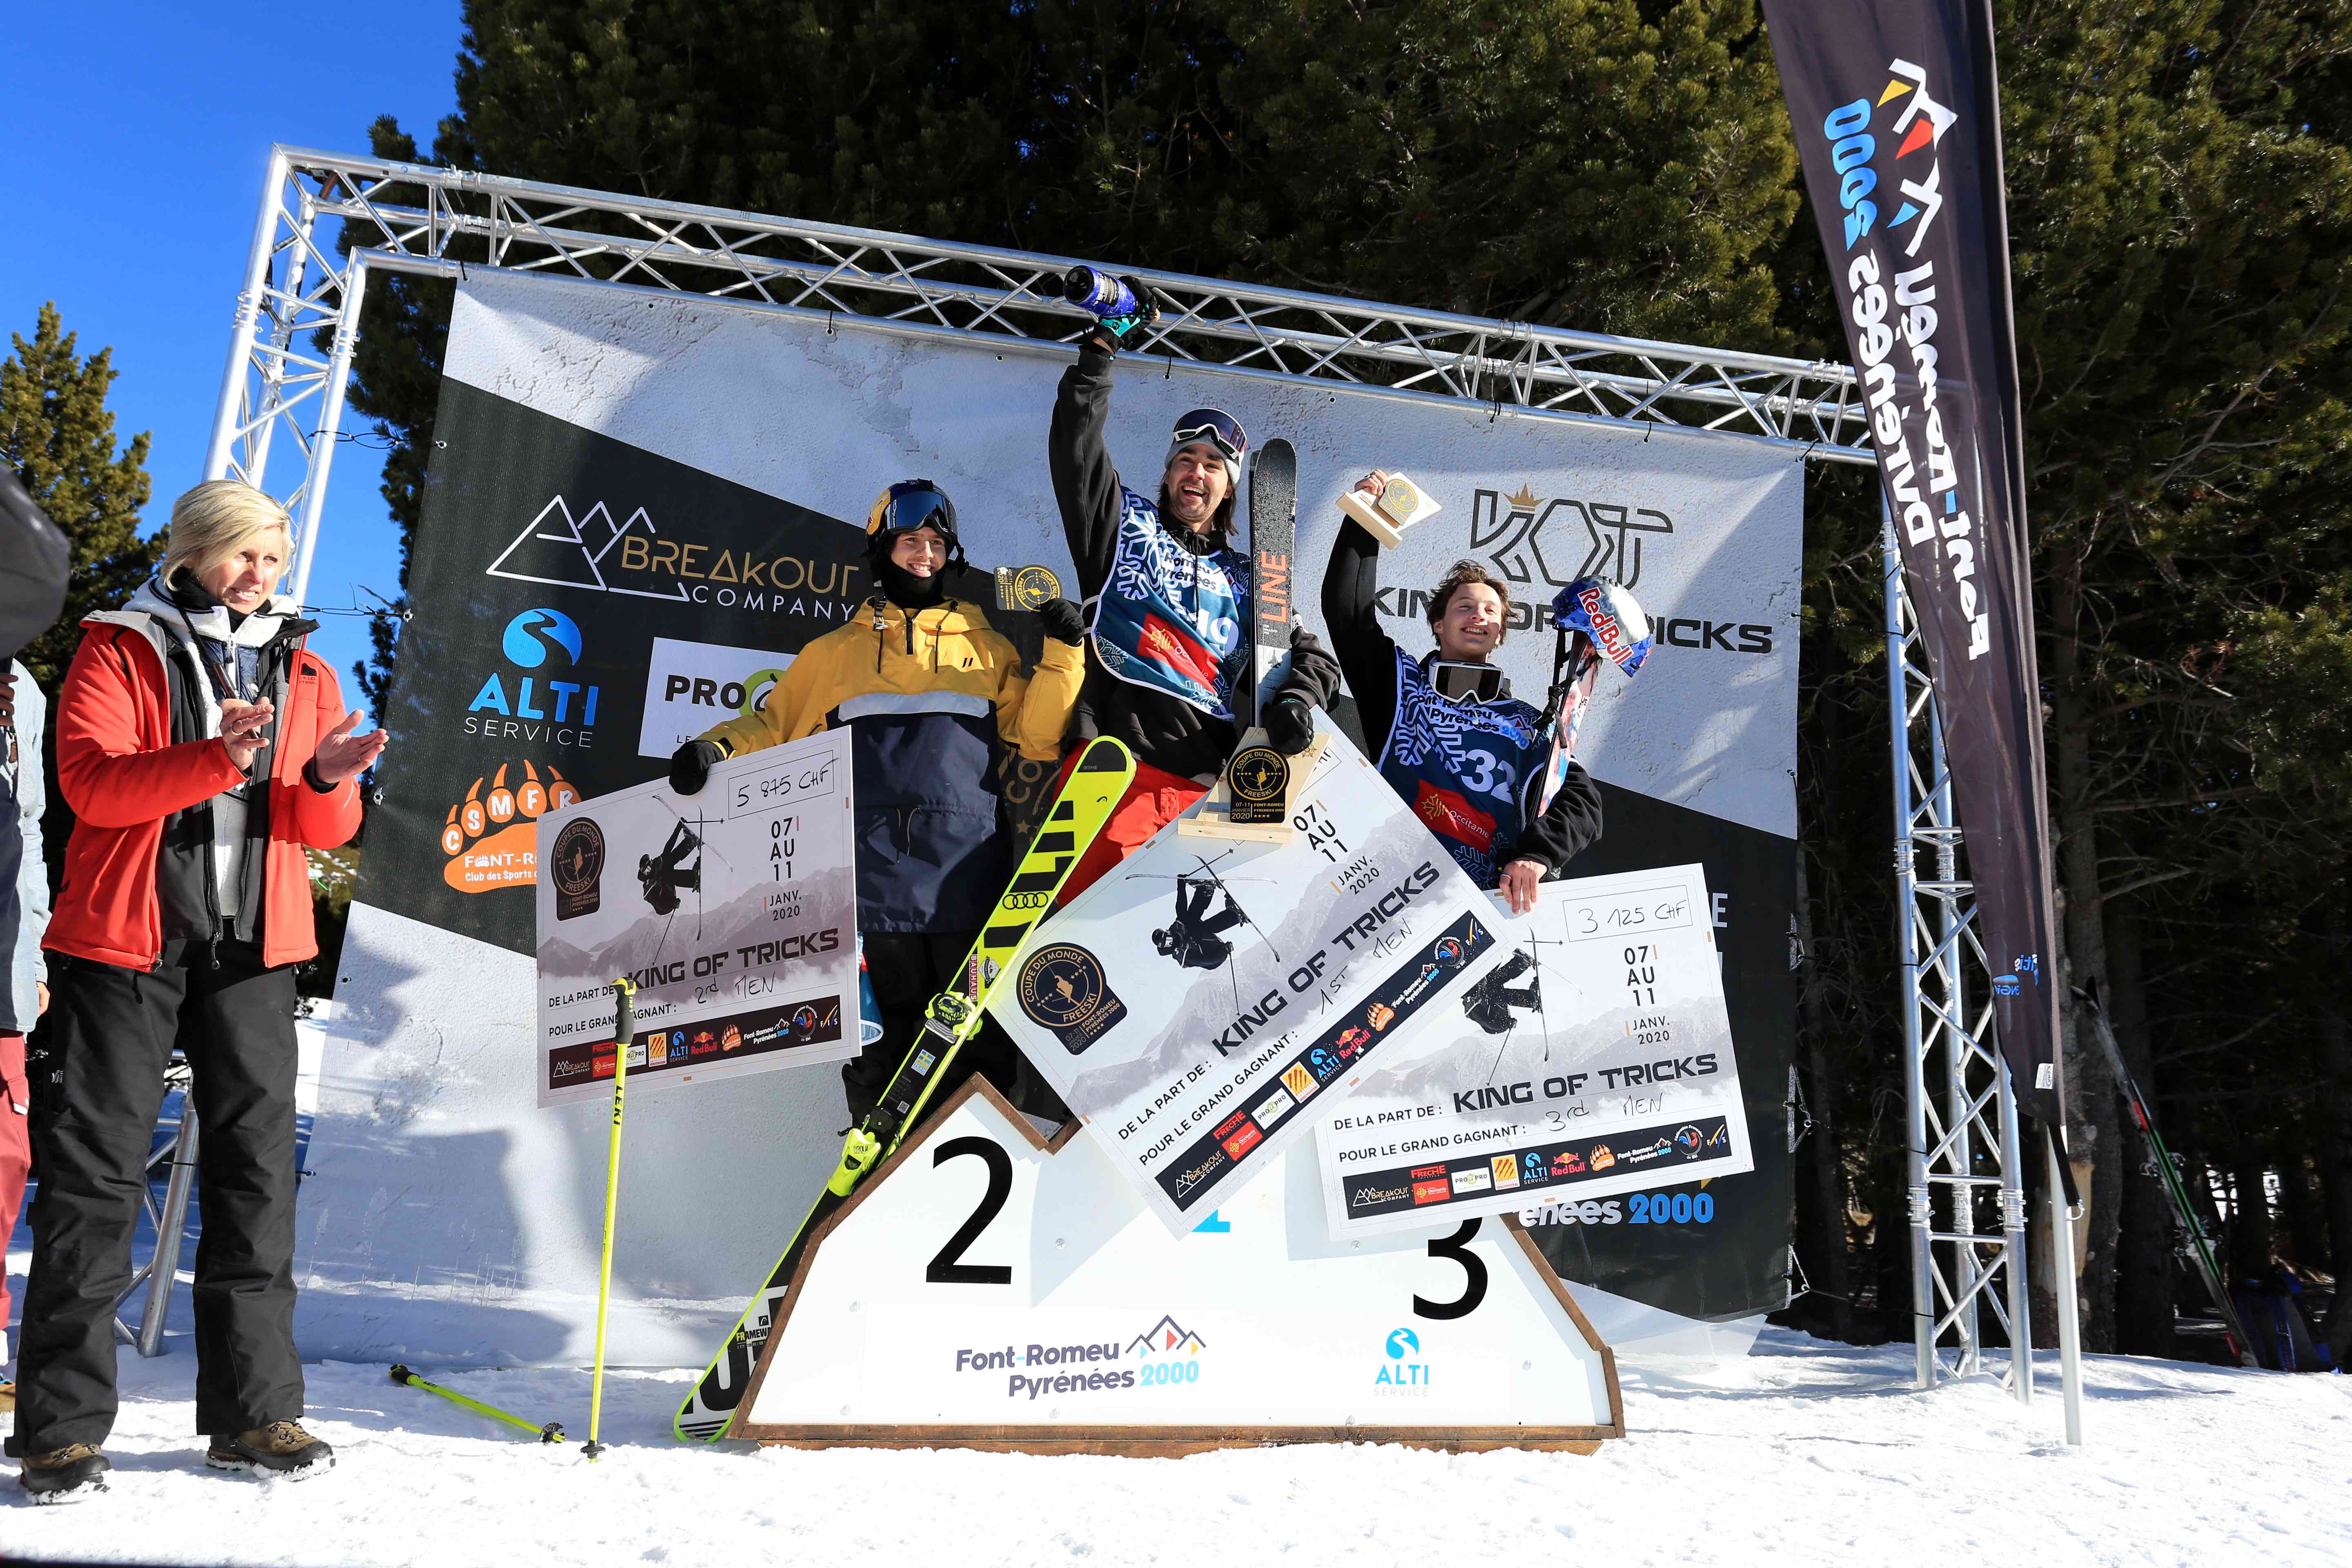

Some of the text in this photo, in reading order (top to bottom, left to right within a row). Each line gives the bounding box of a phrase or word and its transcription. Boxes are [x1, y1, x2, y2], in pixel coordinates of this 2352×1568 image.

[1018, 577, 1026, 601] FREESKI
[1041, 572, 1054, 586] COUPE
[1261, 550, 1287, 623] LINE
[692, 585, 855, 621] COMPANY
[1656, 617, 1772, 653] ICKS
[468, 672, 599, 726] ALTI
[665, 674, 746, 709] PRO
[464, 717, 592, 748] SERVICE
[1236, 753, 1254, 769] COUPE
[1264, 753, 1281, 769] MONDE
[737, 787, 749, 807] 5
[798, 758, 840, 789] CHF
[1461, 749, 1516, 805] 32
[1244, 788, 1273, 797] FREESKI
[771, 818, 793, 839] 07
[1293, 804, 1317, 832] 07
[557, 825, 599, 858] COUPE DU MONDE
[1307, 819, 1336, 850] AU
[770, 840, 795, 861] AU
[1322, 839, 1348, 863] 11
[466, 870, 531, 882] Club des Sports
[774, 862, 792, 881] 11
[1338, 855, 1372, 886] JANV.
[1350, 867, 1380, 895] 2020
[565, 878, 592, 892] FREESKI
[769, 890, 802, 908] JANV.
[773, 905, 800, 920] 2020
[1579, 899, 1687, 933] 3 125 CHF
[1372, 918, 1412, 958] MEN
[628, 928, 839, 990] KING OF TRICKS
[1212, 861, 1440, 1057] KING OF TRICKS
[1624, 945, 1648, 965] 07
[735, 971, 775, 999] MEN
[1024, 951, 1084, 1002] COUPE DU MONDE
[1427, 968, 1440, 982] 2000
[1627, 966, 1655, 986] AU
[549, 996, 561, 1007] DE
[563, 993, 575, 1004] LA
[576, 987, 601, 1001] PART
[1063, 993, 1098, 1022] FREESKI
[1108, 1003, 1120, 1014] 2000
[1633, 987, 1655, 1007] 11
[1082, 998, 1116, 1029] FONT-ROMEU
[1633, 1015, 1670, 1031] JANV.
[549, 1020, 587, 1037] POUR LE
[777, 1028, 789, 1037] 2000
[1637, 1030, 1670, 1045] 2020
[670, 1046, 688, 1058] ALTI
[1316, 1054, 1340, 1079] ALTI
[1321, 1063, 1343, 1083] SERVICE
[1453, 1053, 1718, 1114] KING OF TRICKS
[613, 1085, 623, 1125] LEKI
[1118, 1064, 1206, 1140] DE LA PART DE
[1139, 1134, 1175, 1166] POUR
[1174, 1119, 1192, 1137] LE
[1191, 1083, 1234, 1122] GRAND
[1234, 1033, 1291, 1085] GAGNANT
[1623, 1092, 1663, 1117] MEN
[1334, 1105, 1435, 1130] DE LA PART DE
[1339, 1125, 1519, 1163] POUR LE GRAND GAGNANT
[1617, 1145, 1653, 1160] Font-Romeu
[1658, 1147, 1671, 1156] 2000
[1203, 1155, 1225, 1177] COMPANY
[1523, 1166, 1548, 1179] ALTI
[1523, 1176, 1548, 1185] SERVICE
[925, 1136, 1013, 1284] 2
[1383, 1194, 1410, 1202] COMPANY
[1628, 1193, 1714, 1224] 2000
[1413, 1216, 1488, 1320] 3
[956, 1343, 1119, 1372] Font-Romeu
[1009, 1361, 1199, 1400] Pyrénées 2000
[1375, 1364, 1429, 1385] ALTI
[1374, 1388, 1428, 1396] SERVICE
